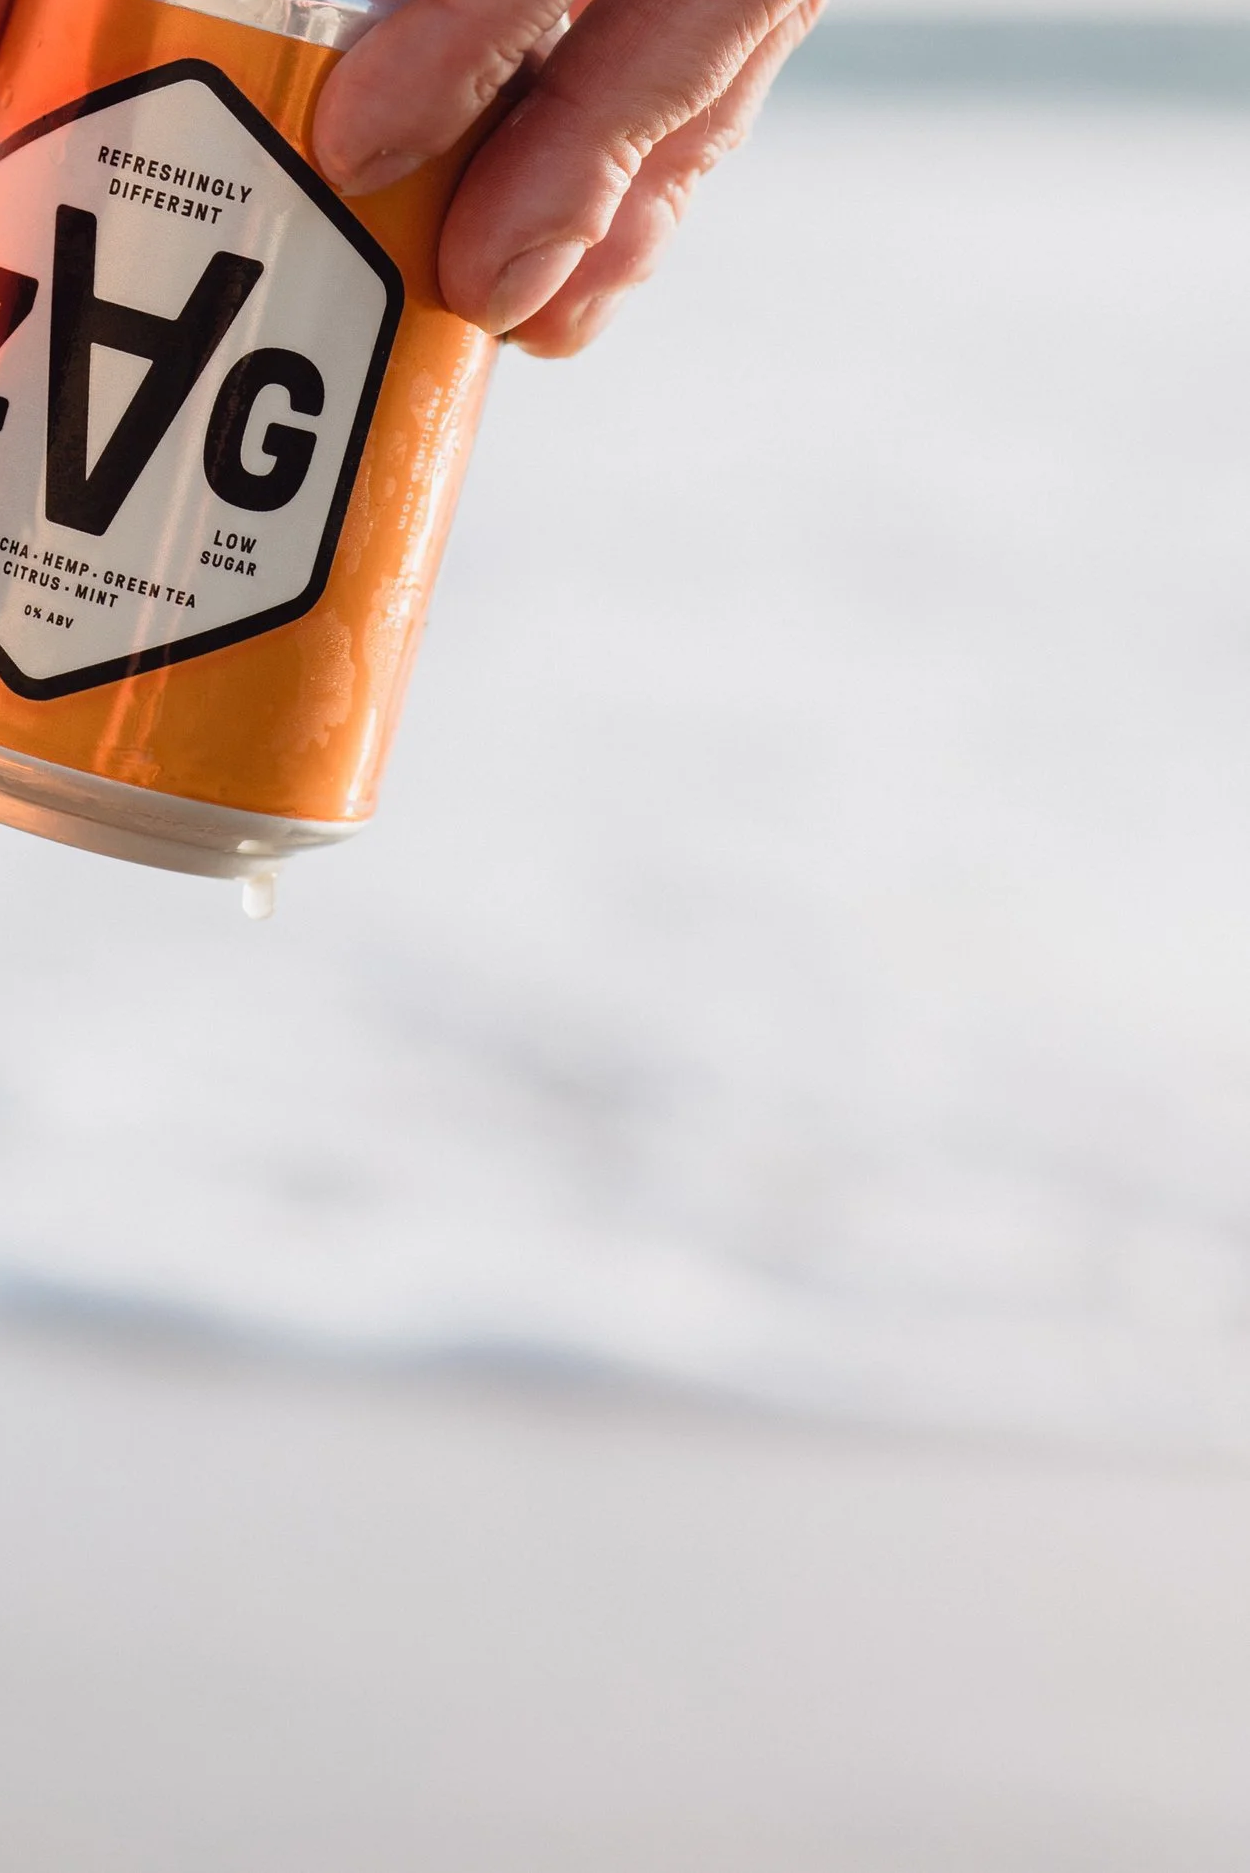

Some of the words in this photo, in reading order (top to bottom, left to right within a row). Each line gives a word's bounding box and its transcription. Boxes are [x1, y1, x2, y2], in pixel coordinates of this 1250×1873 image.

[97, 145, 253, 204] REFRESHINGLY
[213, 529, 257, 555] LOW
[42, 551, 90, 577] HEMP
[103, 570, 161, 599] GREEN
[165, 586, 196, 609] TEA
[199, 550, 257, 577] SUGAR
[2, 560, 61, 591] CITRUS
[74, 583, 119, 608] MINT
[23, 604, 43, 620] 0%
[45, 611, 75, 629] ABV
